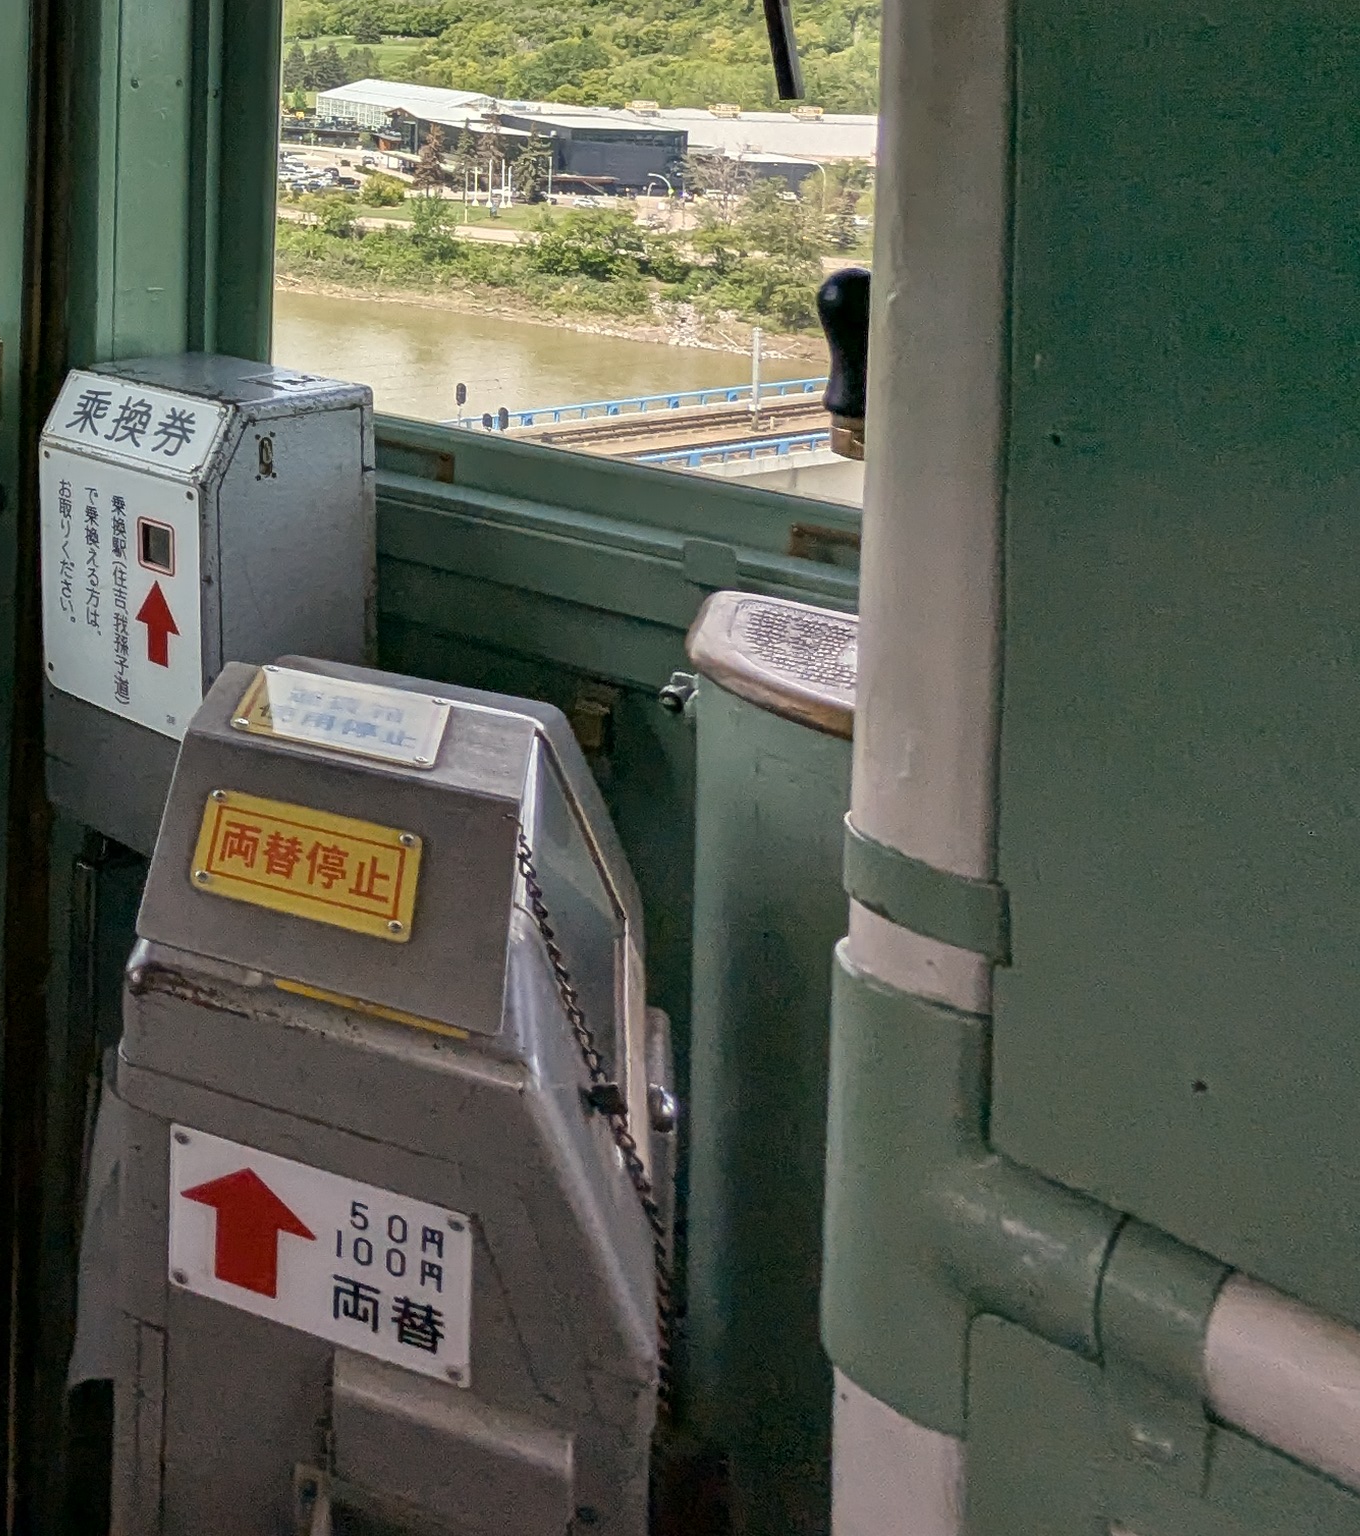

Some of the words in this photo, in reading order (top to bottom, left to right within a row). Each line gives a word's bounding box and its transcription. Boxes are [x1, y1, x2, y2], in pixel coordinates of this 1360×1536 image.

[65, 389, 196, 457] 乗換券
[58, 478, 77, 624] お取りください。
[219, 819, 390, 904] 両替停止
[336, 1229, 443, 1294] 100円
[350, 1200, 444, 1259] 50円
[332, 1273, 446, 1355] 両替
